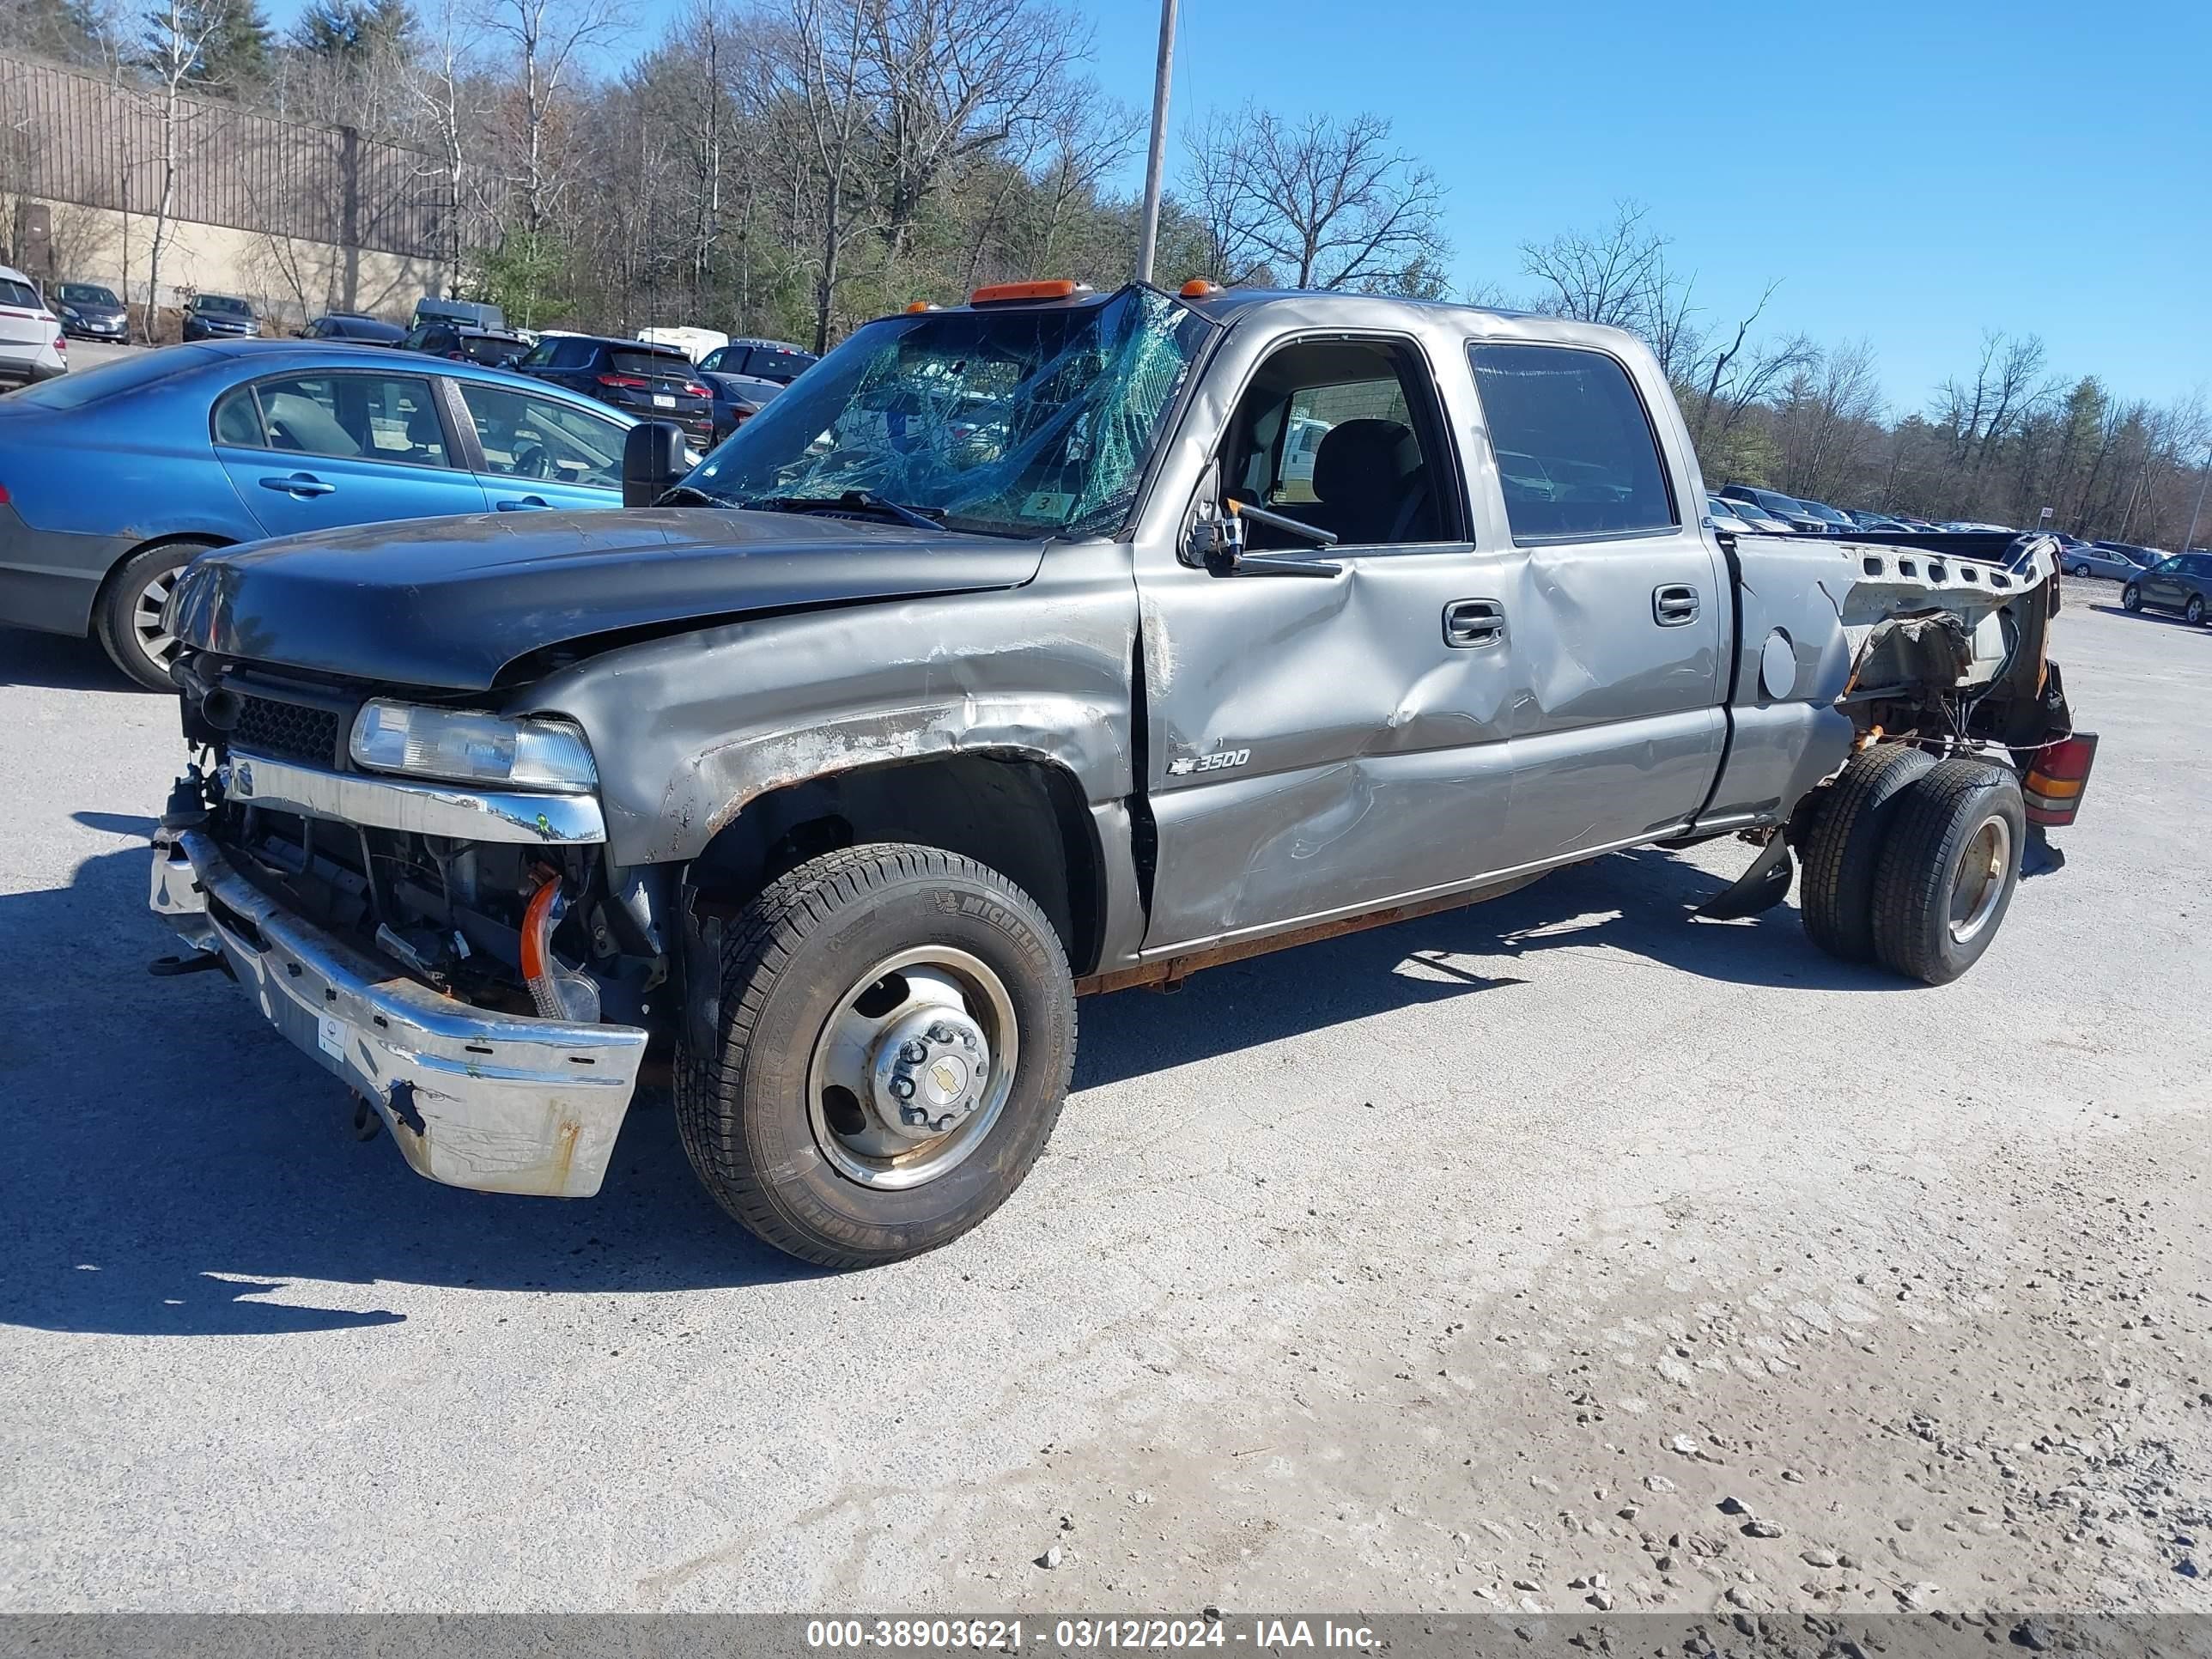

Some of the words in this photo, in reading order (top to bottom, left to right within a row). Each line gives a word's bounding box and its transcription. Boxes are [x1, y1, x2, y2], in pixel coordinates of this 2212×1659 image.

[1036, 496, 1051, 510] 3
[1196, 748, 1251, 772] 3500
[961, 896, 1049, 973] MICHELIN
